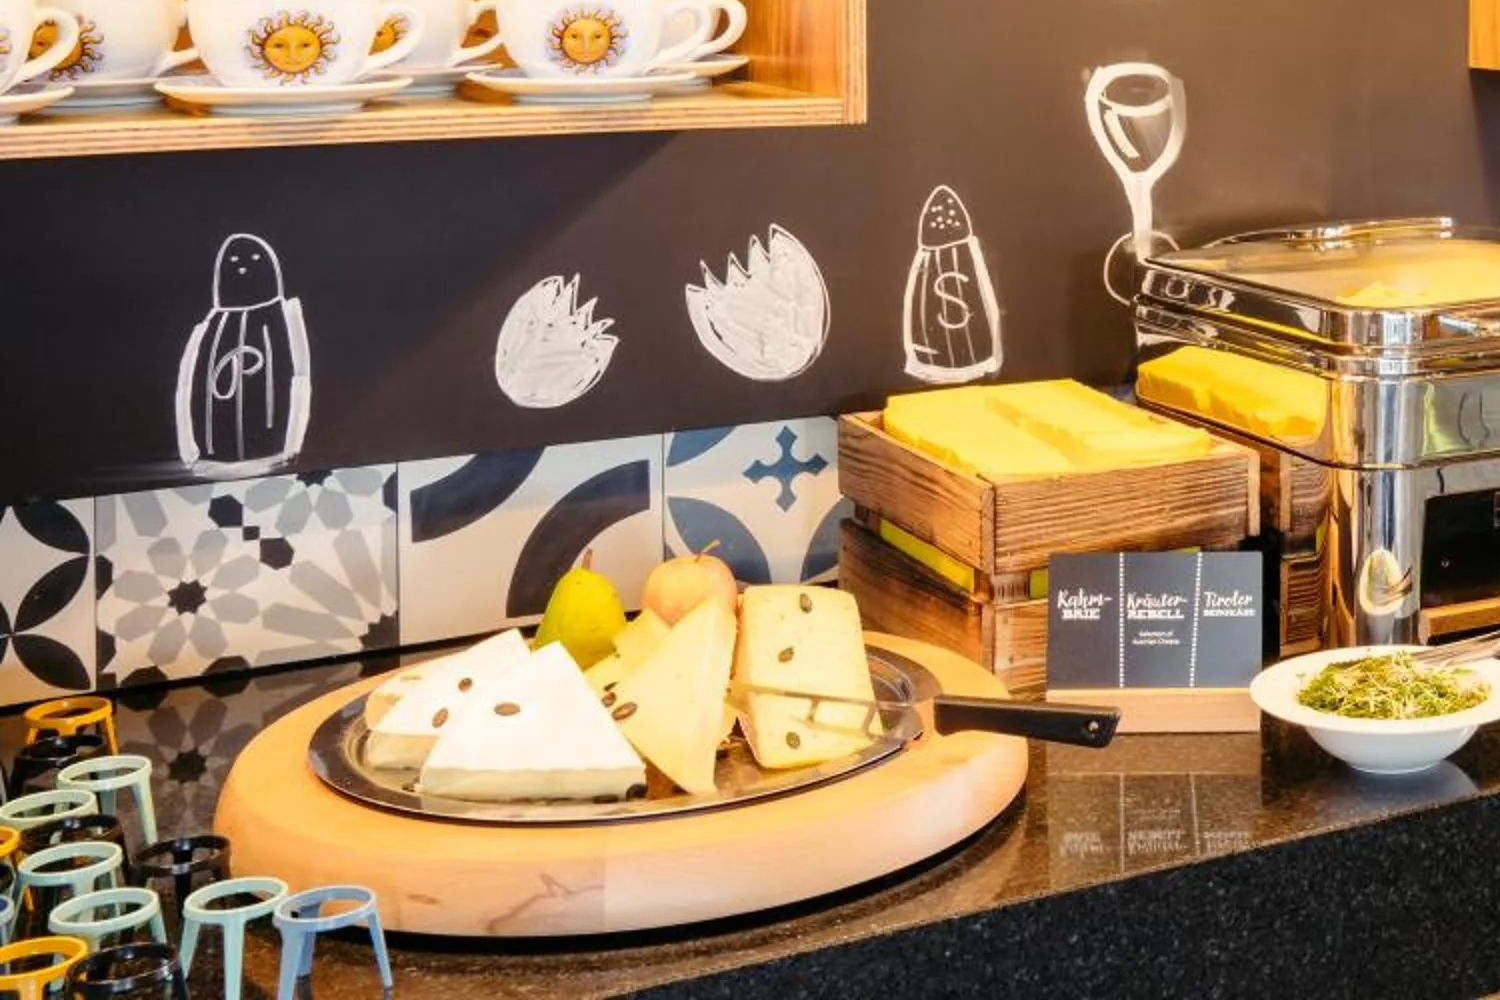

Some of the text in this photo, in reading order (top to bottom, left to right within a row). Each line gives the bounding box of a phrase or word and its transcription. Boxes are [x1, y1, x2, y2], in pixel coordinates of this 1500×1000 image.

[933, 271, 970, 329] S
[1127, 592, 1188, 609] Kräuter-
[1203, 590, 1253, 608] Tiroler
[1062, 608, 1101, 620] BRIE
[1127, 608, 1185, 620] REBELL
